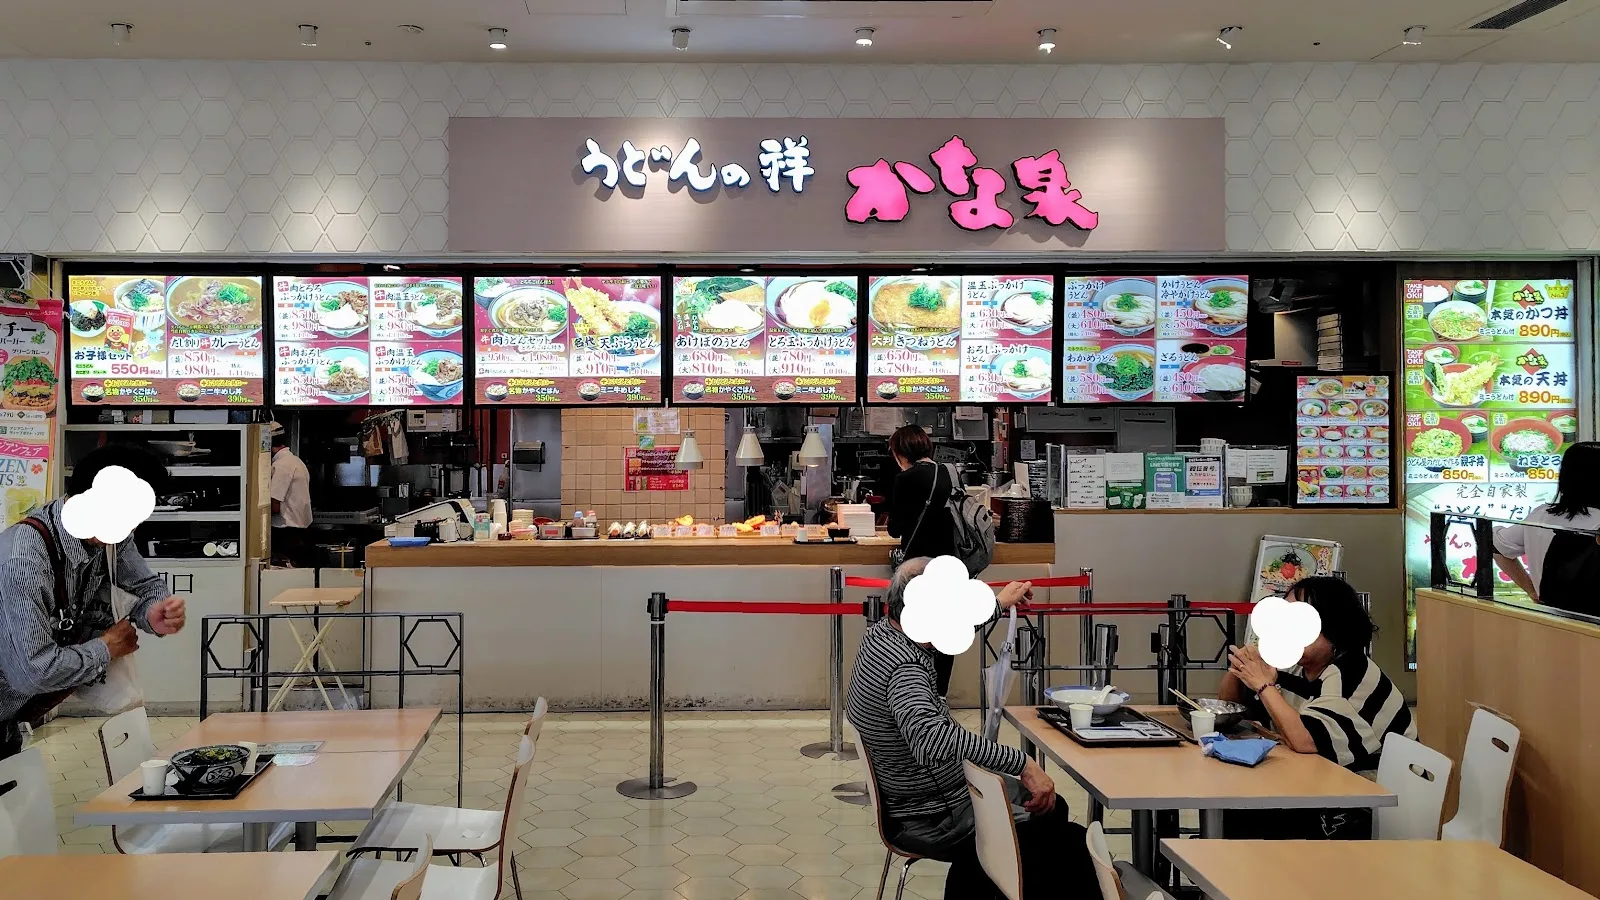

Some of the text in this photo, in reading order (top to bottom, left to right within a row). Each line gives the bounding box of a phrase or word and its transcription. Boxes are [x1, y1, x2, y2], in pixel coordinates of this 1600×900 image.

[581, 134, 1099, 231] うどんの祥 かな泉
[967, 280, 1025, 290] 温玉ぶっかけ
[1067, 281, 1105, 291] ぶっかけ
[1161, 279, 1201, 289] かけうどん
[967, 290, 987, 299] うどん
[1069, 291, 1089, 300] うどん
[1160, 289, 1212, 300] 冷やかけうどん
[1490, 305, 1569, 321] 本気のかつ丼
[1080, 320, 1107, 331] 610円
[1173, 319, 1200, 330] 580円
[1519, 324, 1560, 338] 890円
[676, 335, 748, 348] あけぼのうどん
[769, 336, 853, 348] とろ玉ぶっかけうどん
[871, 335, 955, 347] 大判 きつねうどん
[966, 345, 1029, 354] おろしぶっかけ
[74, 350, 132, 361] お子様セット
[184, 351, 215, 363] 850円
[692, 350, 723, 362] 680円
[966, 355, 986, 363] うどん
[1067, 353, 1117, 363] わかめうどん
[1160, 352, 1199, 362] ざるうどん
[111, 363, 149, 375] 550円
[184, 364, 216, 376] 980円
[1499, 371, 1568, 387] 本気の天丼
[600, 386, 641, 394] ミニ牛めし丼
[1519, 390, 1560, 404] 890円
[1442, 469, 1474, 481] 850円
[1456, 483, 1528, 499] 完全自家製
